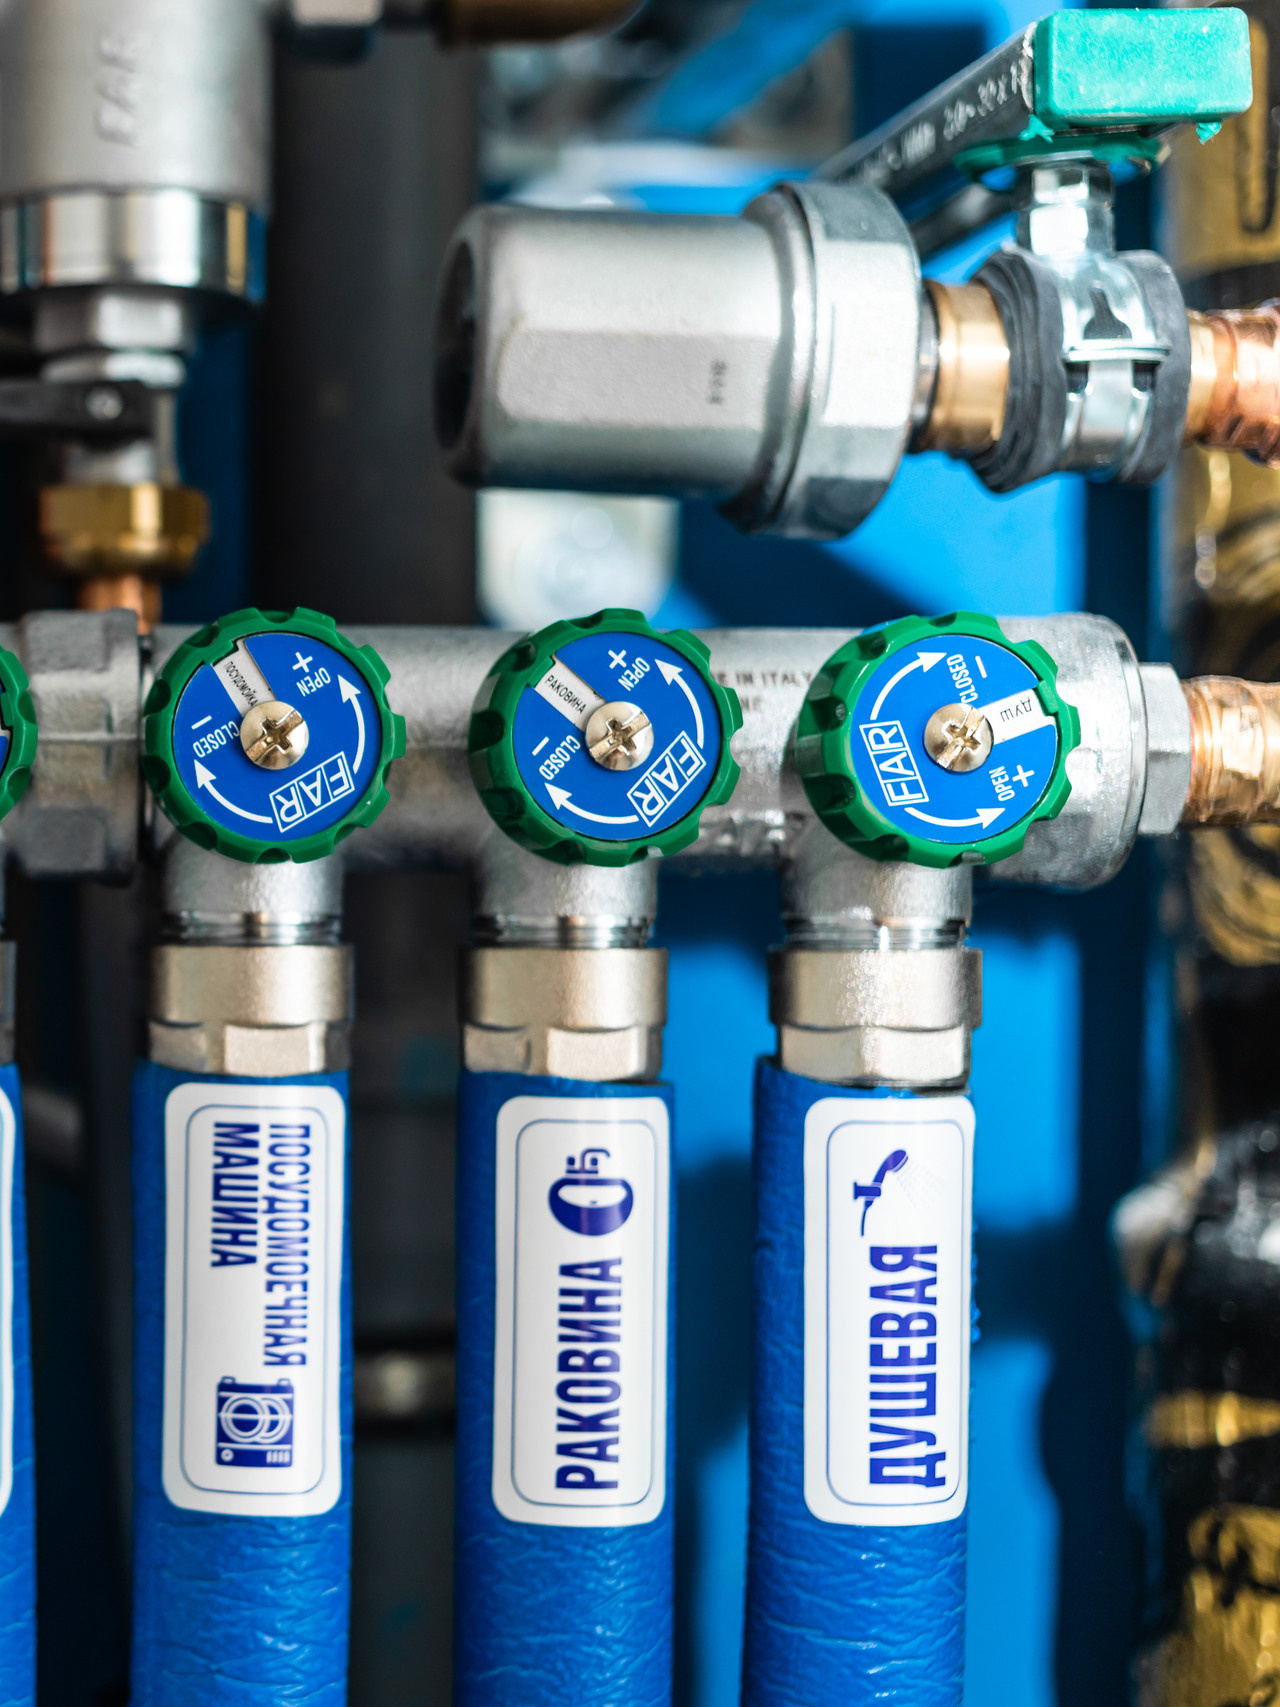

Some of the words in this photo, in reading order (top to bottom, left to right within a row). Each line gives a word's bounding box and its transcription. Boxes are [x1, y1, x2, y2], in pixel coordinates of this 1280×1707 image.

[223, 661, 258, 707] ПОСУДОМОЙКА
[296, 667, 331, 697] OPEN
[545, 675, 587, 715] РАКОВИНА
[617, 657, 650, 692] OPEN
[946, 653, 979, 704] CLOSED
[999, 696, 1033, 722] ДУШ
[192, 720, 240, 758] CLOSED
[538, 735, 581, 781] CLOSED
[630, 735, 703, 822] FAR
[864, 723, 926, 804] FAR
[988, 766, 1015, 801] OPEN
[273, 755, 352, 827] FAR
[210, 1121, 260, 1268] МАШИНА
[261, 1123, 311, 1367] ПОСУДОМОЕЧНАЯ
[555, 1257, 622, 1490] РАКОВИНА
[869, 1245, 947, 1488] ДУШЕВАЯ
